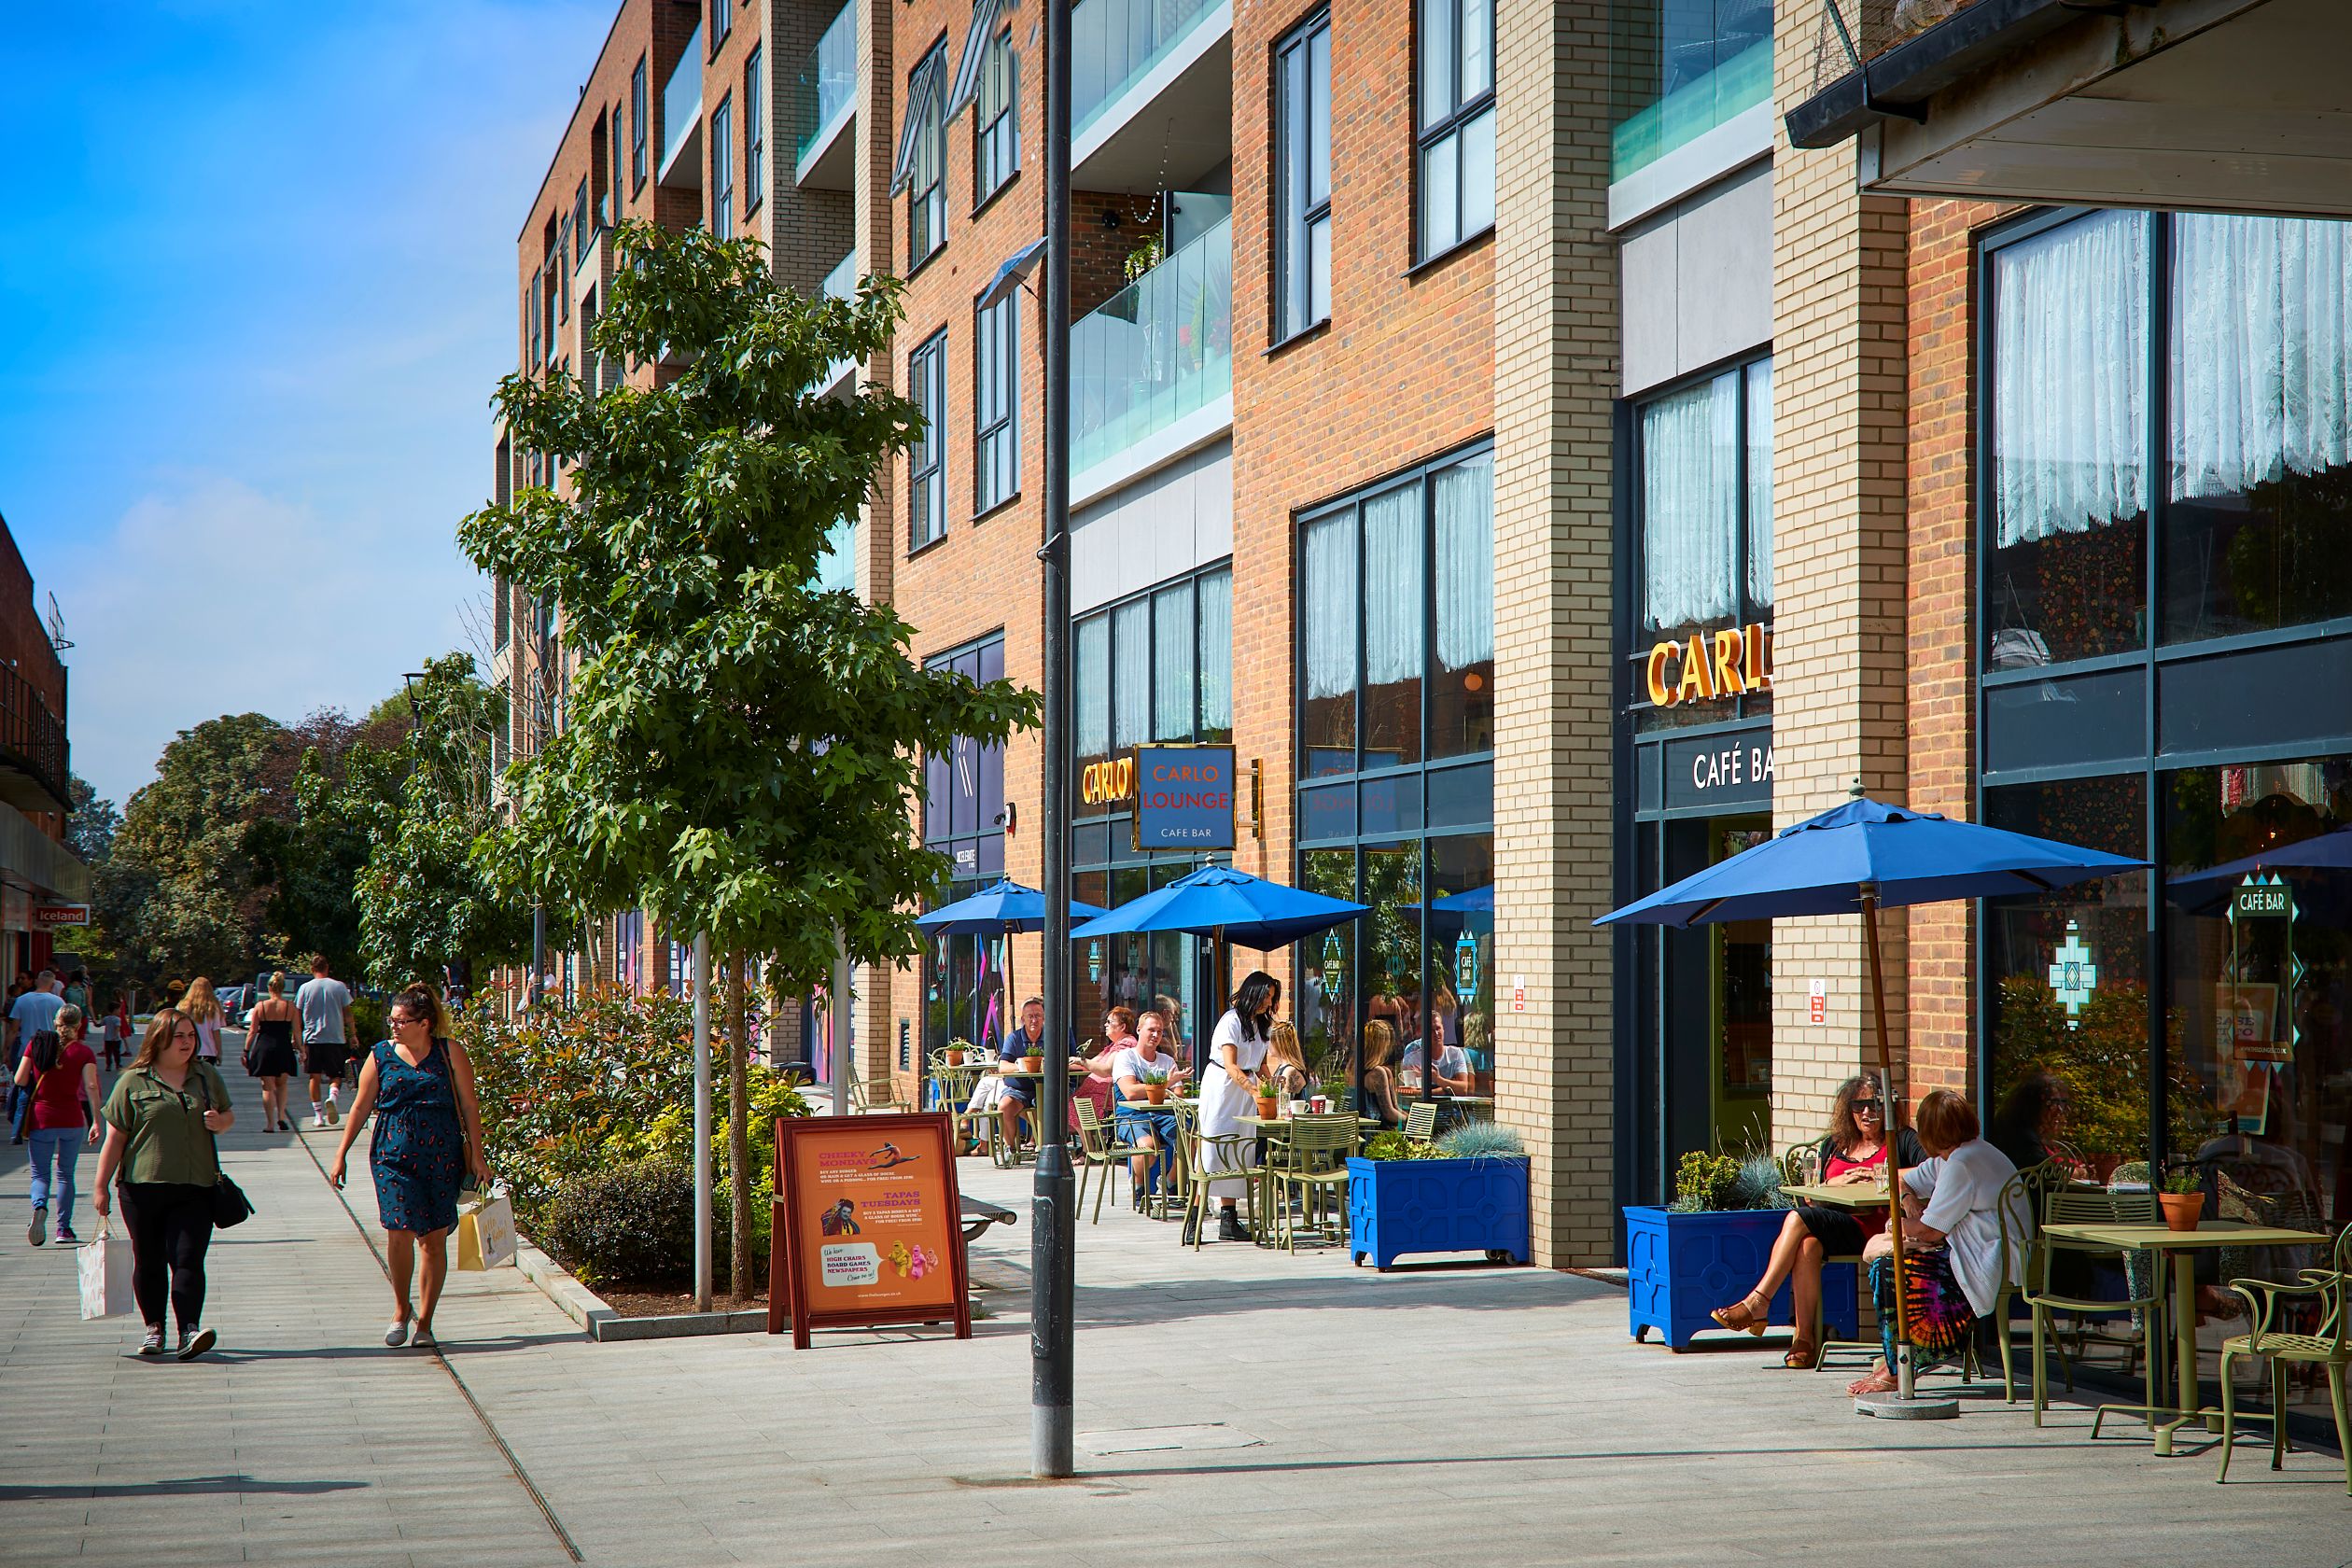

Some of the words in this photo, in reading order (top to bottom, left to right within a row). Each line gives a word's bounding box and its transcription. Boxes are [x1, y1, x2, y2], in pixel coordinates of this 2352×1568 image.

[1646, 623, 1773, 708] CARL
[1693, 741, 1742, 789] CAFÉ
[1751, 745, 1773, 782] BA
[1083, 757, 1132, 805] CARLO
[1153, 765, 1218, 782] CARLO
[1143, 792, 1228, 809] LOUNGE
[1161, 828, 1187, 837] CAFE
[1192, 828, 1211, 837] BAR
[2240, 889, 2263, 910] CAFÉ
[2266, 892, 2285, 910] BAR
[39, 910, 83, 921] Iceland
[1461, 953, 1472, 968] CAFÉ
[1462, 969, 1471, 980] BAR
[819, 1151, 866, 1159] CHEEKY
[819, 1158, 878, 1167] MONDAYS
